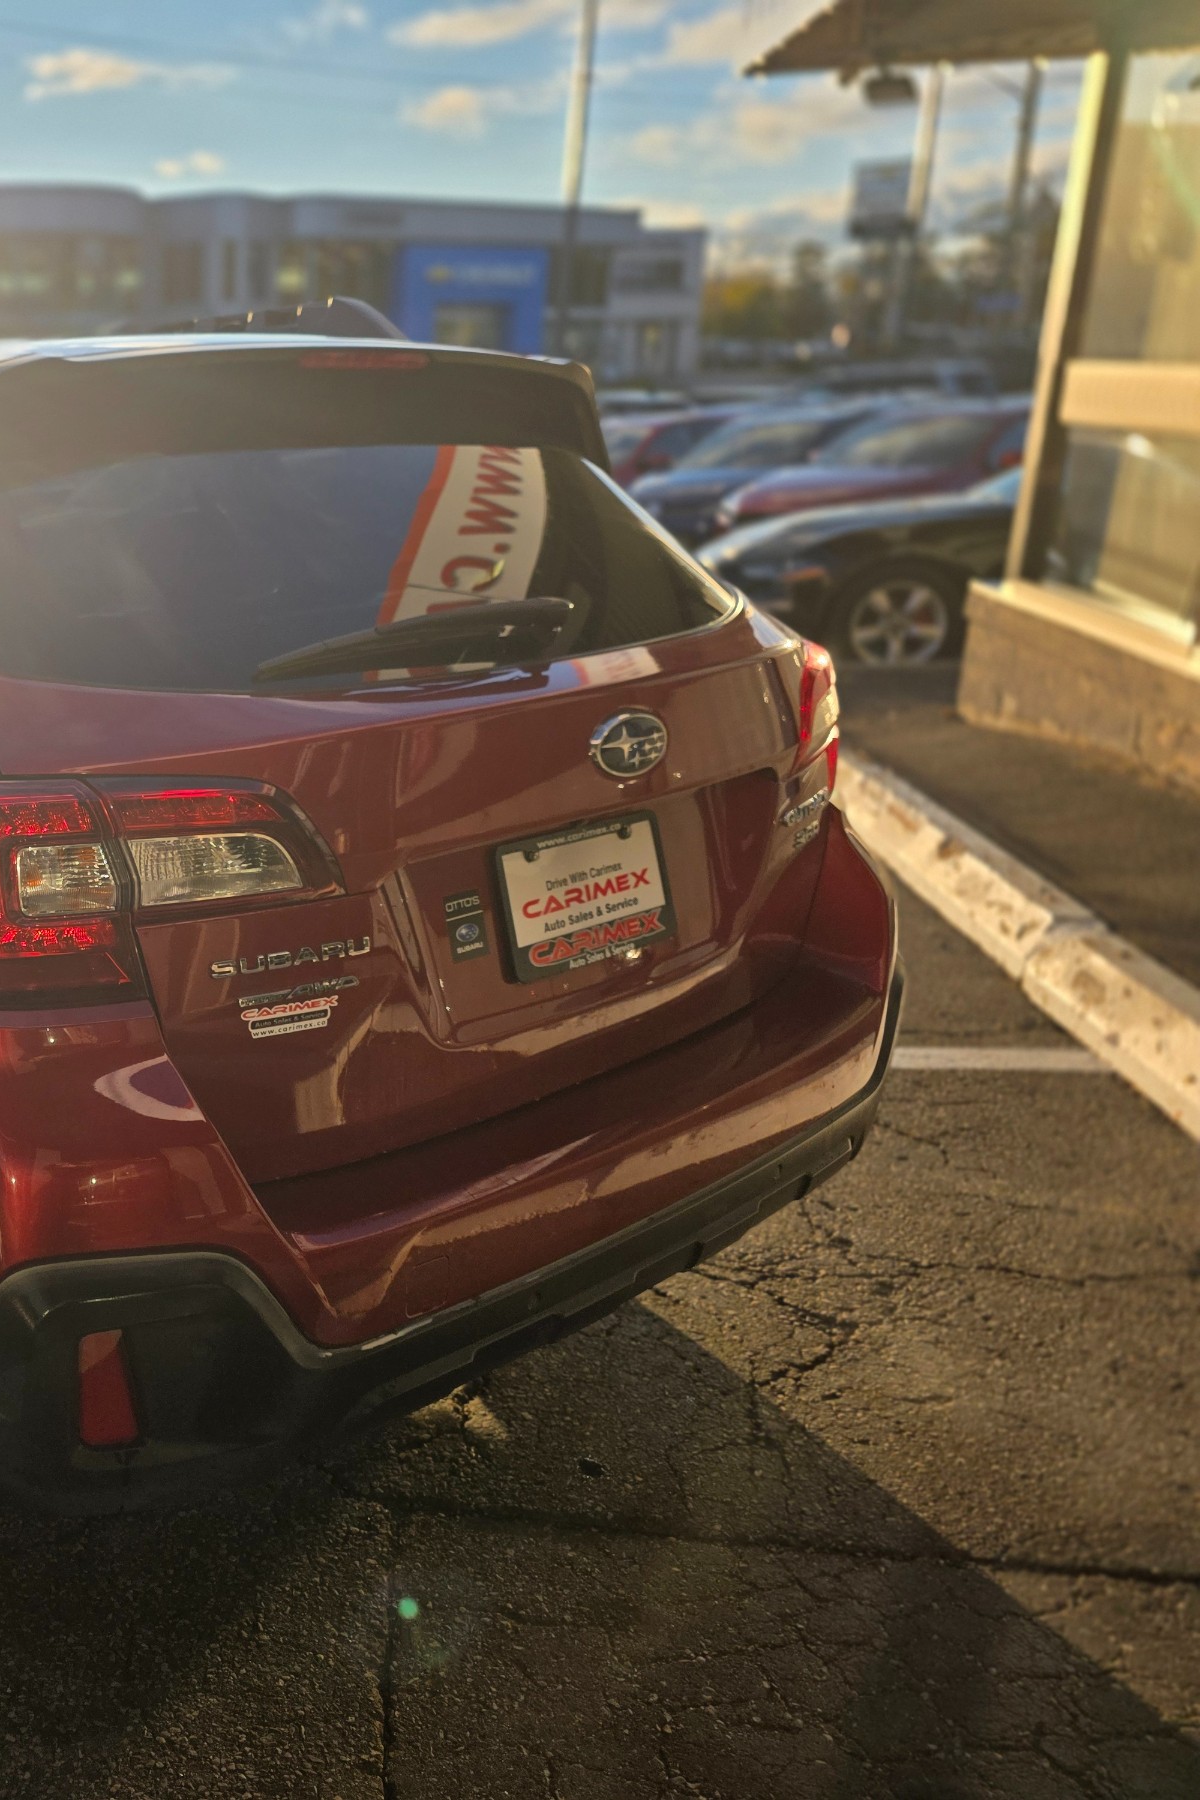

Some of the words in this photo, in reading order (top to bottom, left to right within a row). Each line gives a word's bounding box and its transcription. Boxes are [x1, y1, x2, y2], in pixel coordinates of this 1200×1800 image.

[536, 823, 622, 849] www.carimex.co
[546, 877, 568, 891] Drive
[569, 869, 589, 885] With
[590, 862, 622, 878] Carimex
[522, 868, 650, 919] CARIMEX
[544, 920, 566, 933] Auto
[568, 911, 594, 926] Sales
[596, 907, 603, 916] &
[605, 896, 638, 914] Service
[530, 910, 664, 966] CARIMEX
[211, 936, 370, 979] SUBARU
[569, 956, 586, 969] Auto
[587, 950, 604, 964] Sales
[286, 975, 360, 1000] AWD
[242, 996, 338, 1020] CARIMEX
[255, 1020, 272, 1028] Auto
[274, 1017, 293, 1026] Sales
[300, 1011, 326, 1021] Service
[252, 1020, 326, 1037] www.carimex.co
